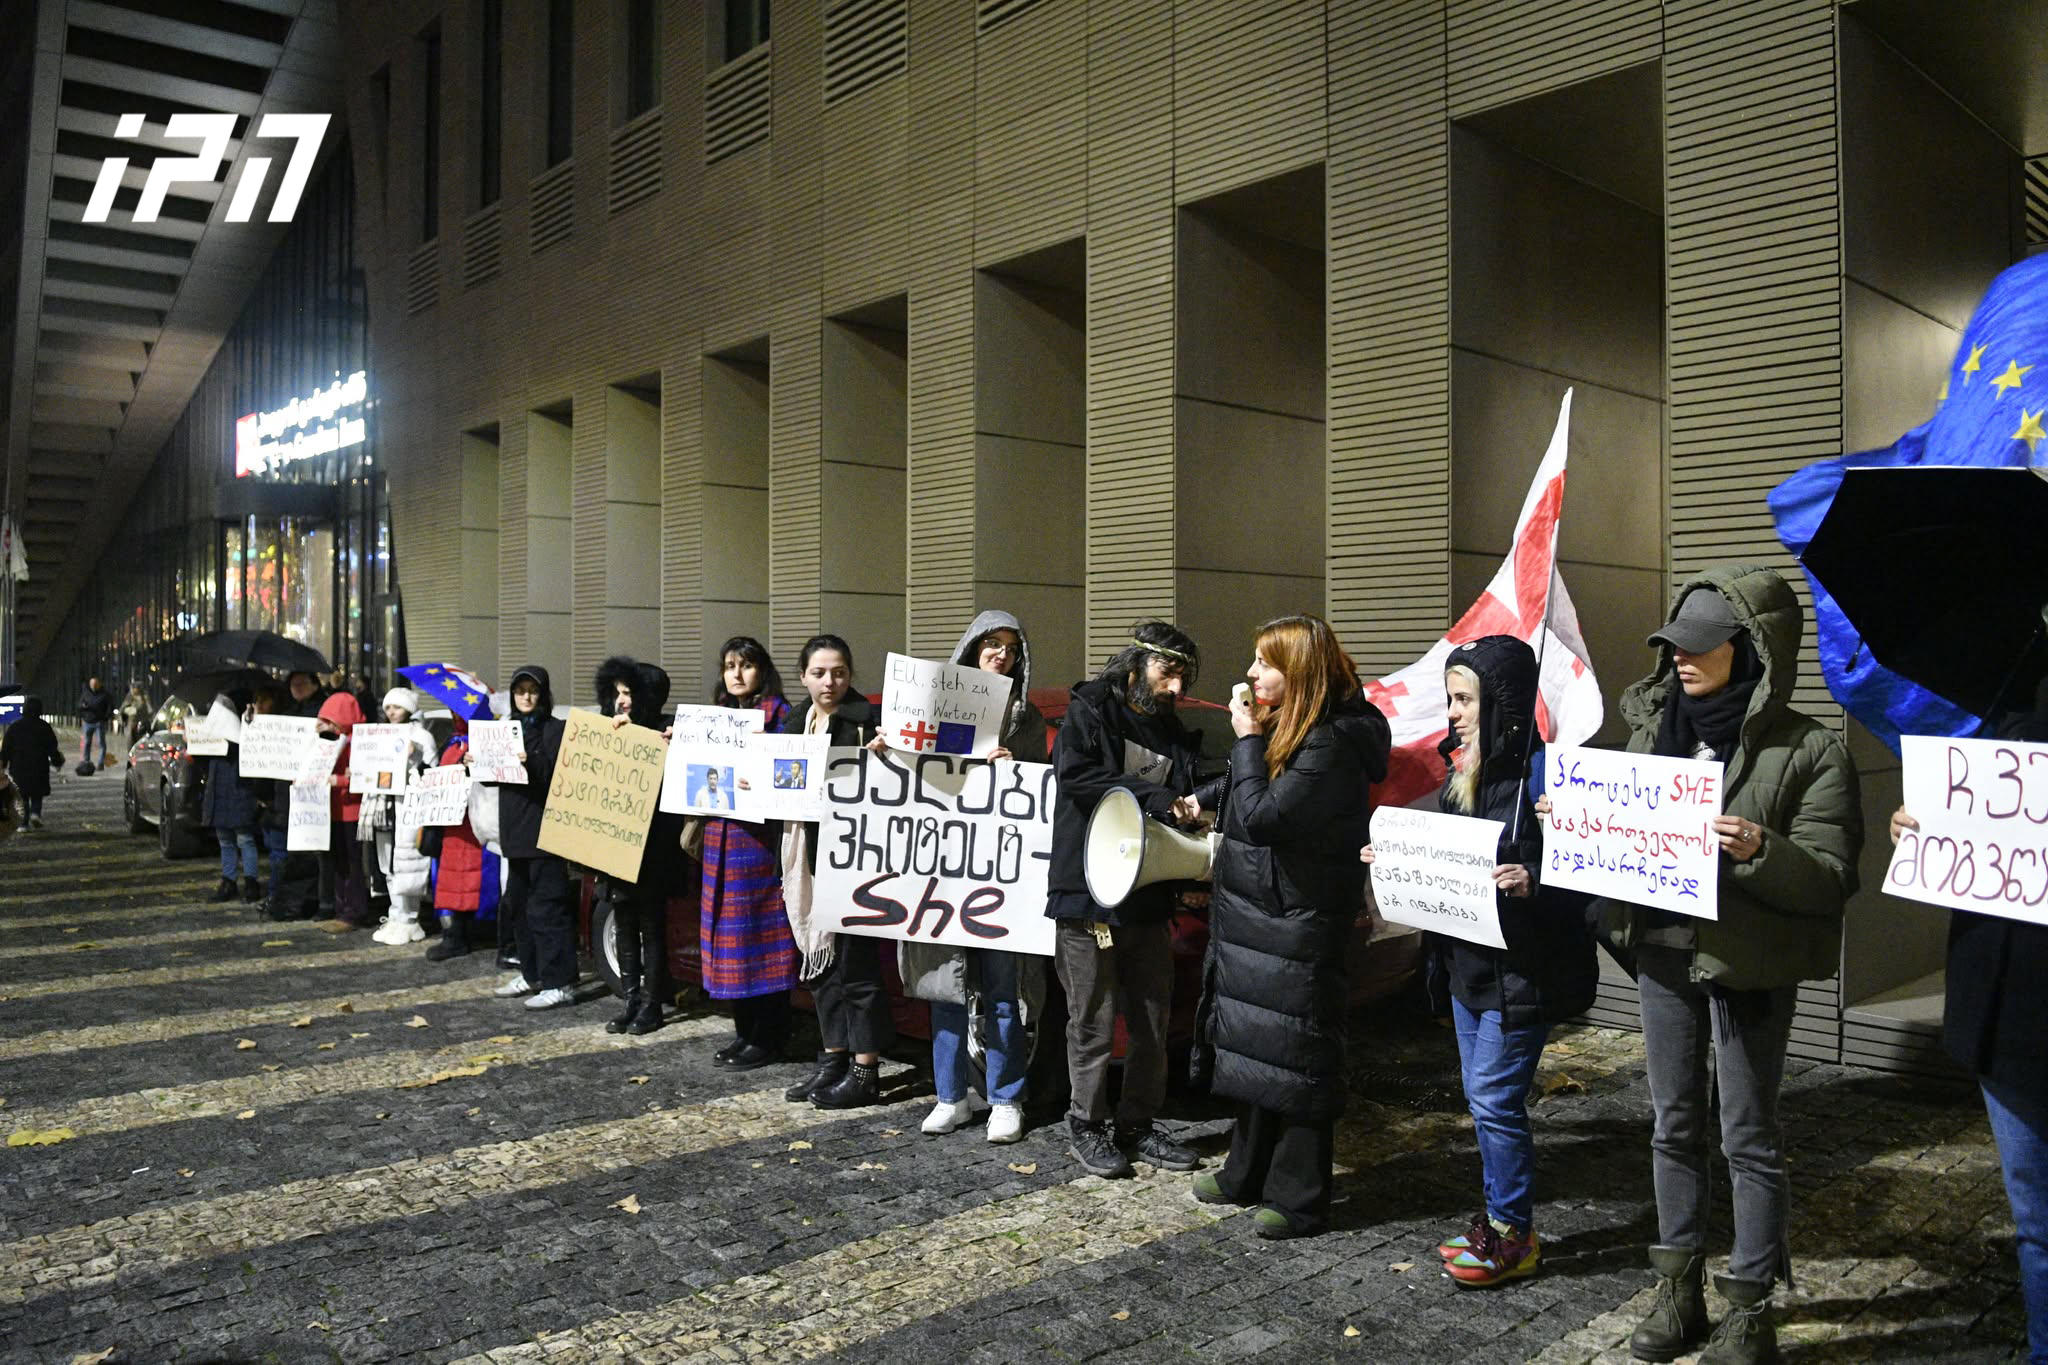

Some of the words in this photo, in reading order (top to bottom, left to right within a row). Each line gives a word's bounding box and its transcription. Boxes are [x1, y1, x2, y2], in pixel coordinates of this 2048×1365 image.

[931, 671, 965, 691] steh
[971, 684, 990, 696] zu
[1669, 774, 1716, 805] SHE
[1550, 801, 1714, 860] საქართველოს
[1372, 865, 1489, 898] დანაშაულები
[1551, 845, 1699, 899] გადასარჩენად
[841, 871, 1010, 940] She
[1382, 893, 1403, 908] არ
